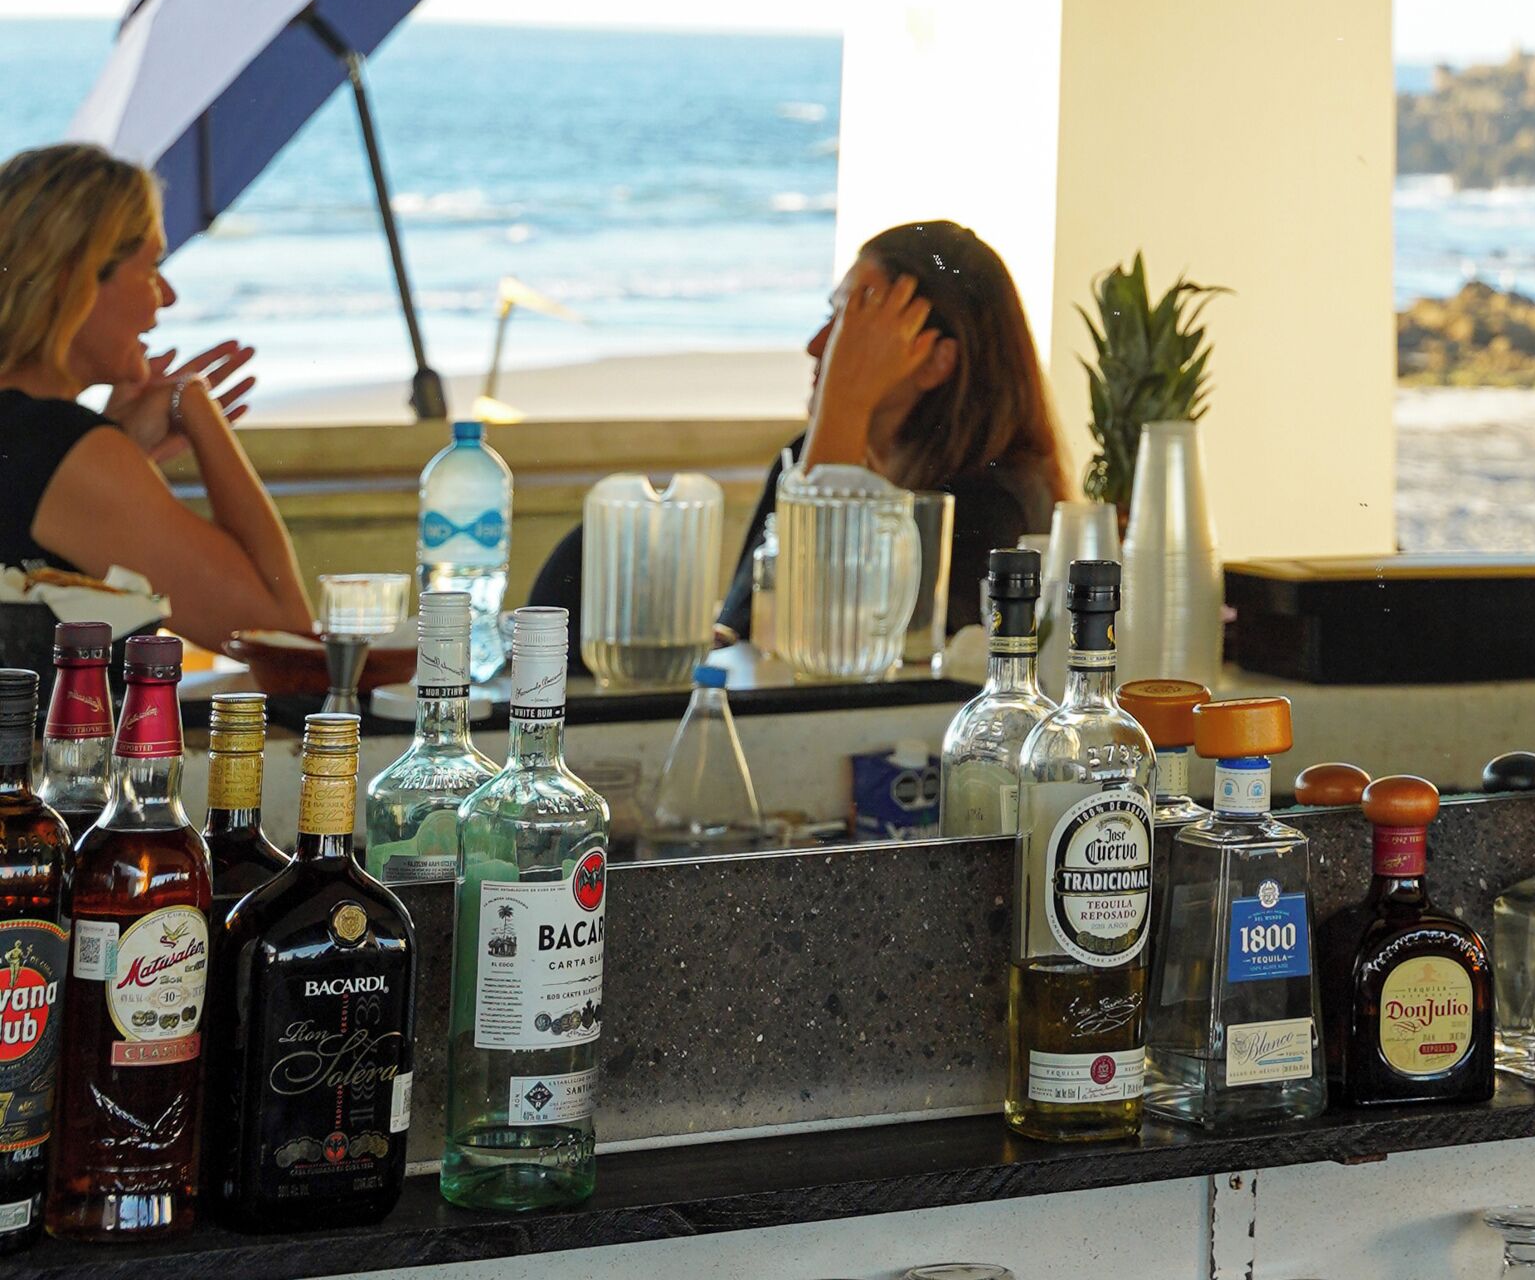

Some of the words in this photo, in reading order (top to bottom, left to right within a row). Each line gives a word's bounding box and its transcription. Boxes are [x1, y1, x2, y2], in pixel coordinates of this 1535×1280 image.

[514, 708, 536, 719] WHITE
[537, 707, 553, 718] RUM
[1076, 803, 1105, 826] 100%
[1109, 800, 1122, 812] DE
[1125, 802, 1149, 824] AGAVE
[1085, 838, 1137, 866] Cuervo
[1063, 869, 1150, 891] TRADICIONAL
[1080, 909, 1138, 921] REPOSADO
[1086, 899, 1134, 911] TEQUILA
[1240, 922, 1297, 954] 1800
[548, 958, 587, 971] CARTA
[589, 953, 603, 966] BLA
[1251, 955, 1288, 965] TEQUILA
[304, 975, 386, 997] BACARDI
[1407, 985, 1448, 993] TEQUILA
[278, 1019, 329, 1043] Ron
[1238, 1030, 1295, 1066] Blanco
[269, 1028, 406, 1096] Solera
[1046, 1069, 1081, 1078] TEQUILA
